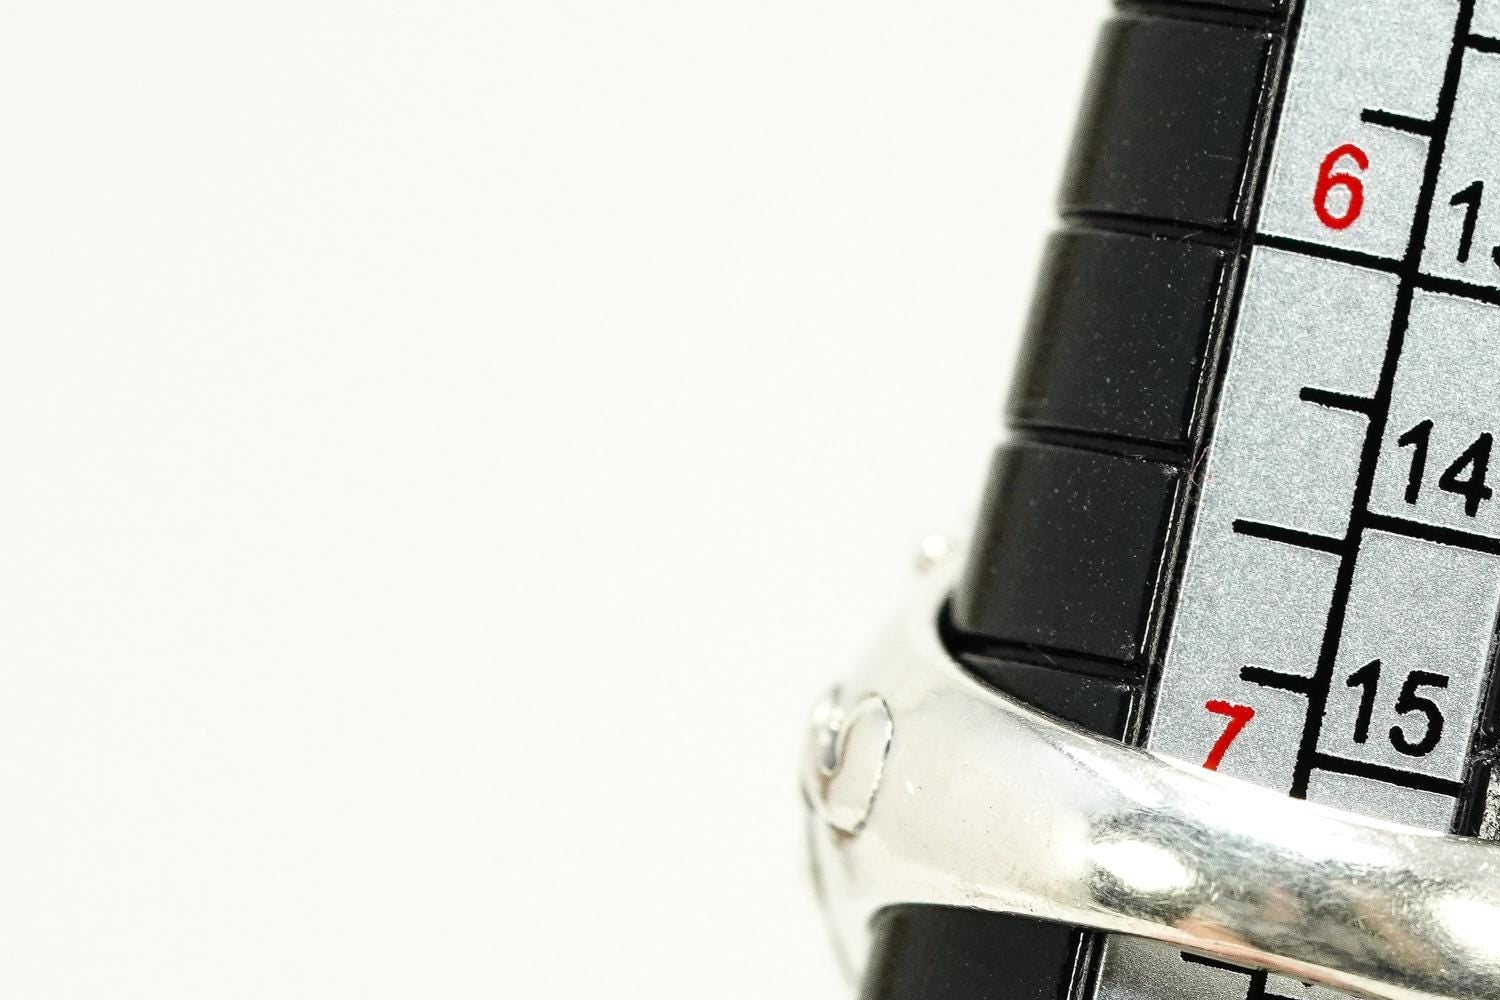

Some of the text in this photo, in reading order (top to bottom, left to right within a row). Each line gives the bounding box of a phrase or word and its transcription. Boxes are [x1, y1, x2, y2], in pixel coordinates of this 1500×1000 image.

[1313, 143, 1369, 231] 6
[1397, 419, 1494, 518] 14
[1203, 699, 1255, 771] 7
[1345, 658, 1450, 758] 15
